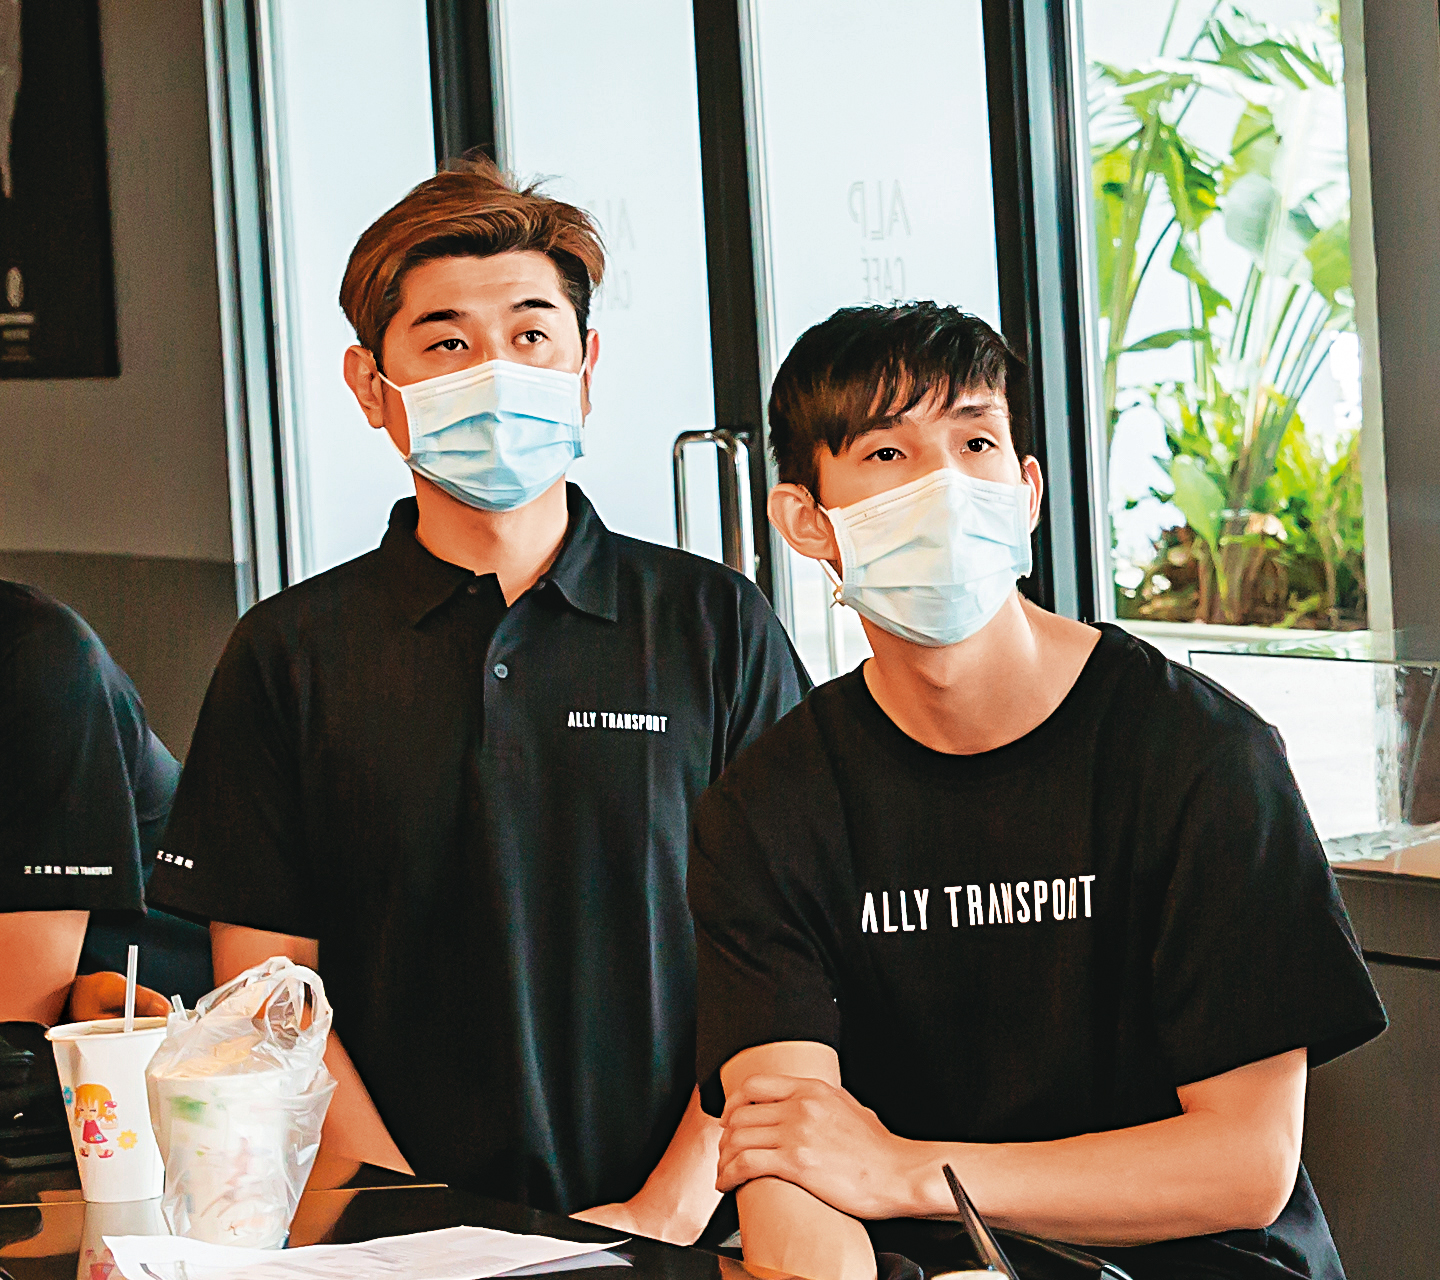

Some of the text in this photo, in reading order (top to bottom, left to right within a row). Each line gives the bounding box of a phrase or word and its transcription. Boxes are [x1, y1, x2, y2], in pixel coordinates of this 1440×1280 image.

[567, 711, 668, 733] ALLY TRANSPORT
[861, 874, 1096, 934] ALLY TRANSPORT
